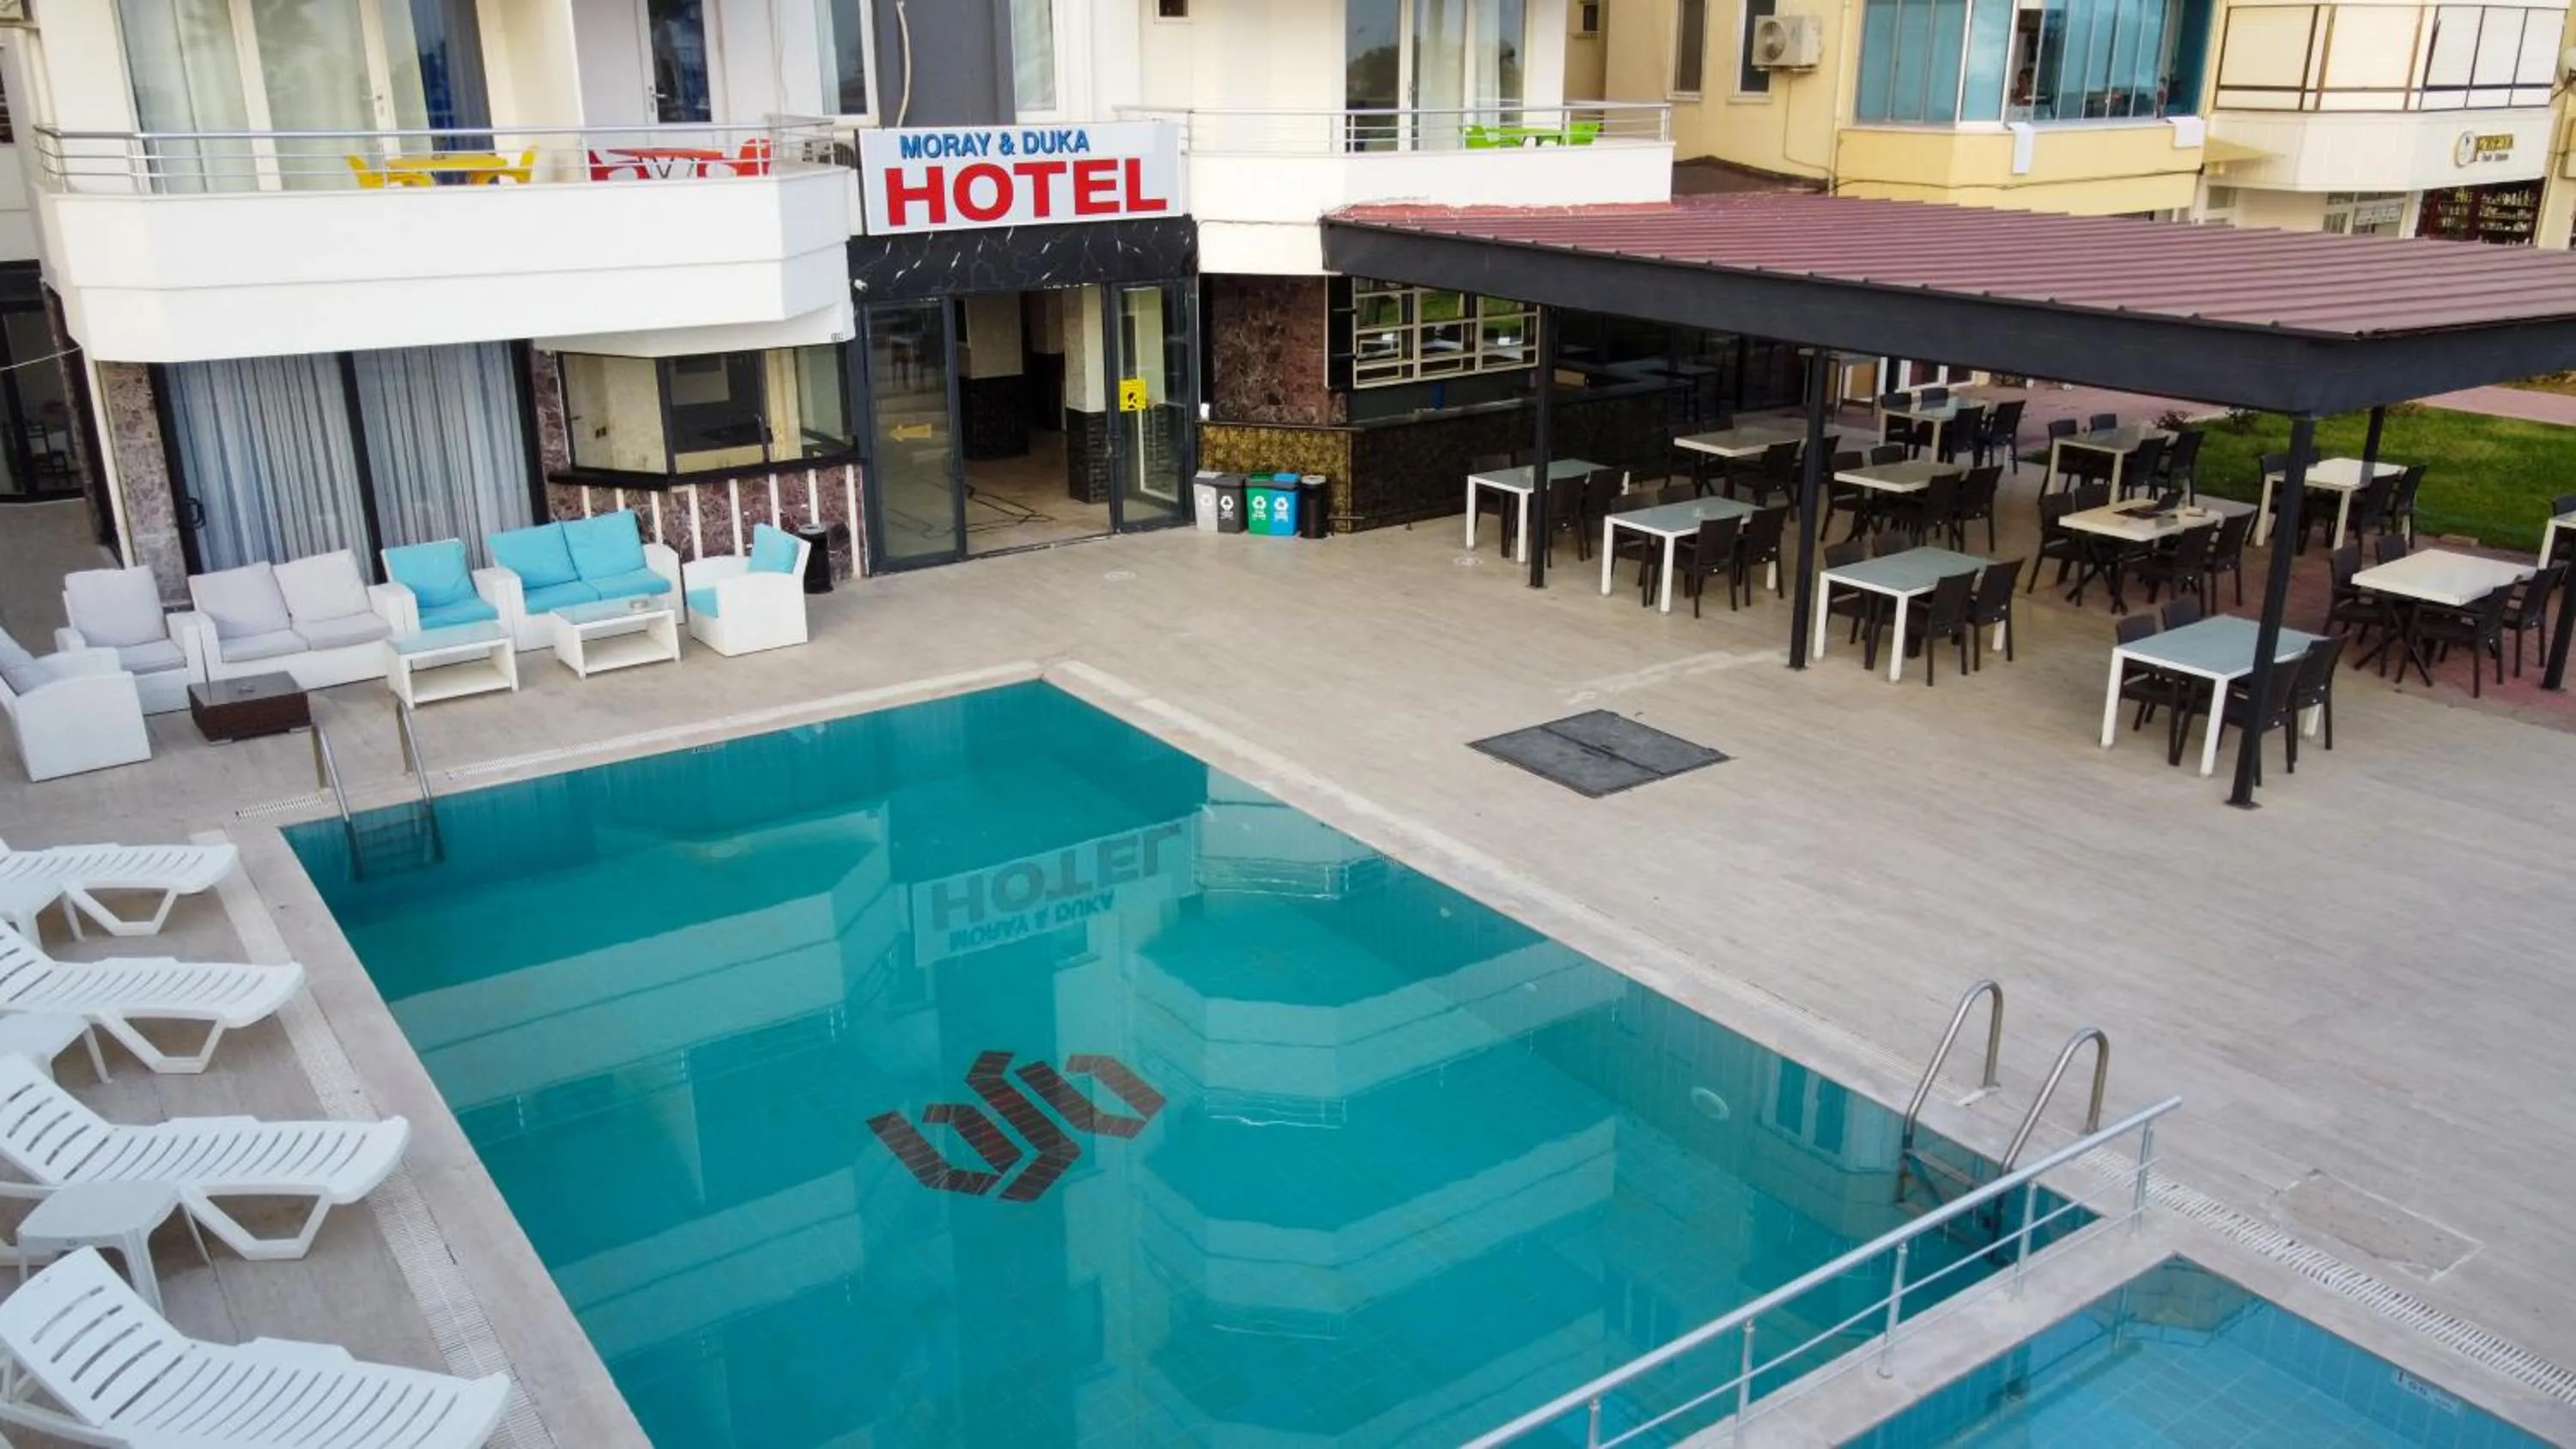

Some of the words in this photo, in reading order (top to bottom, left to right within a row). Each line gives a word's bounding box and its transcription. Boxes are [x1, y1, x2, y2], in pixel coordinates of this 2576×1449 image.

[900, 132, 991, 158] MORAY
[999, 133, 1015, 156] &
[1023, 130, 1090, 154] DUKA
[884, 158, 1168, 227] HOTEL
